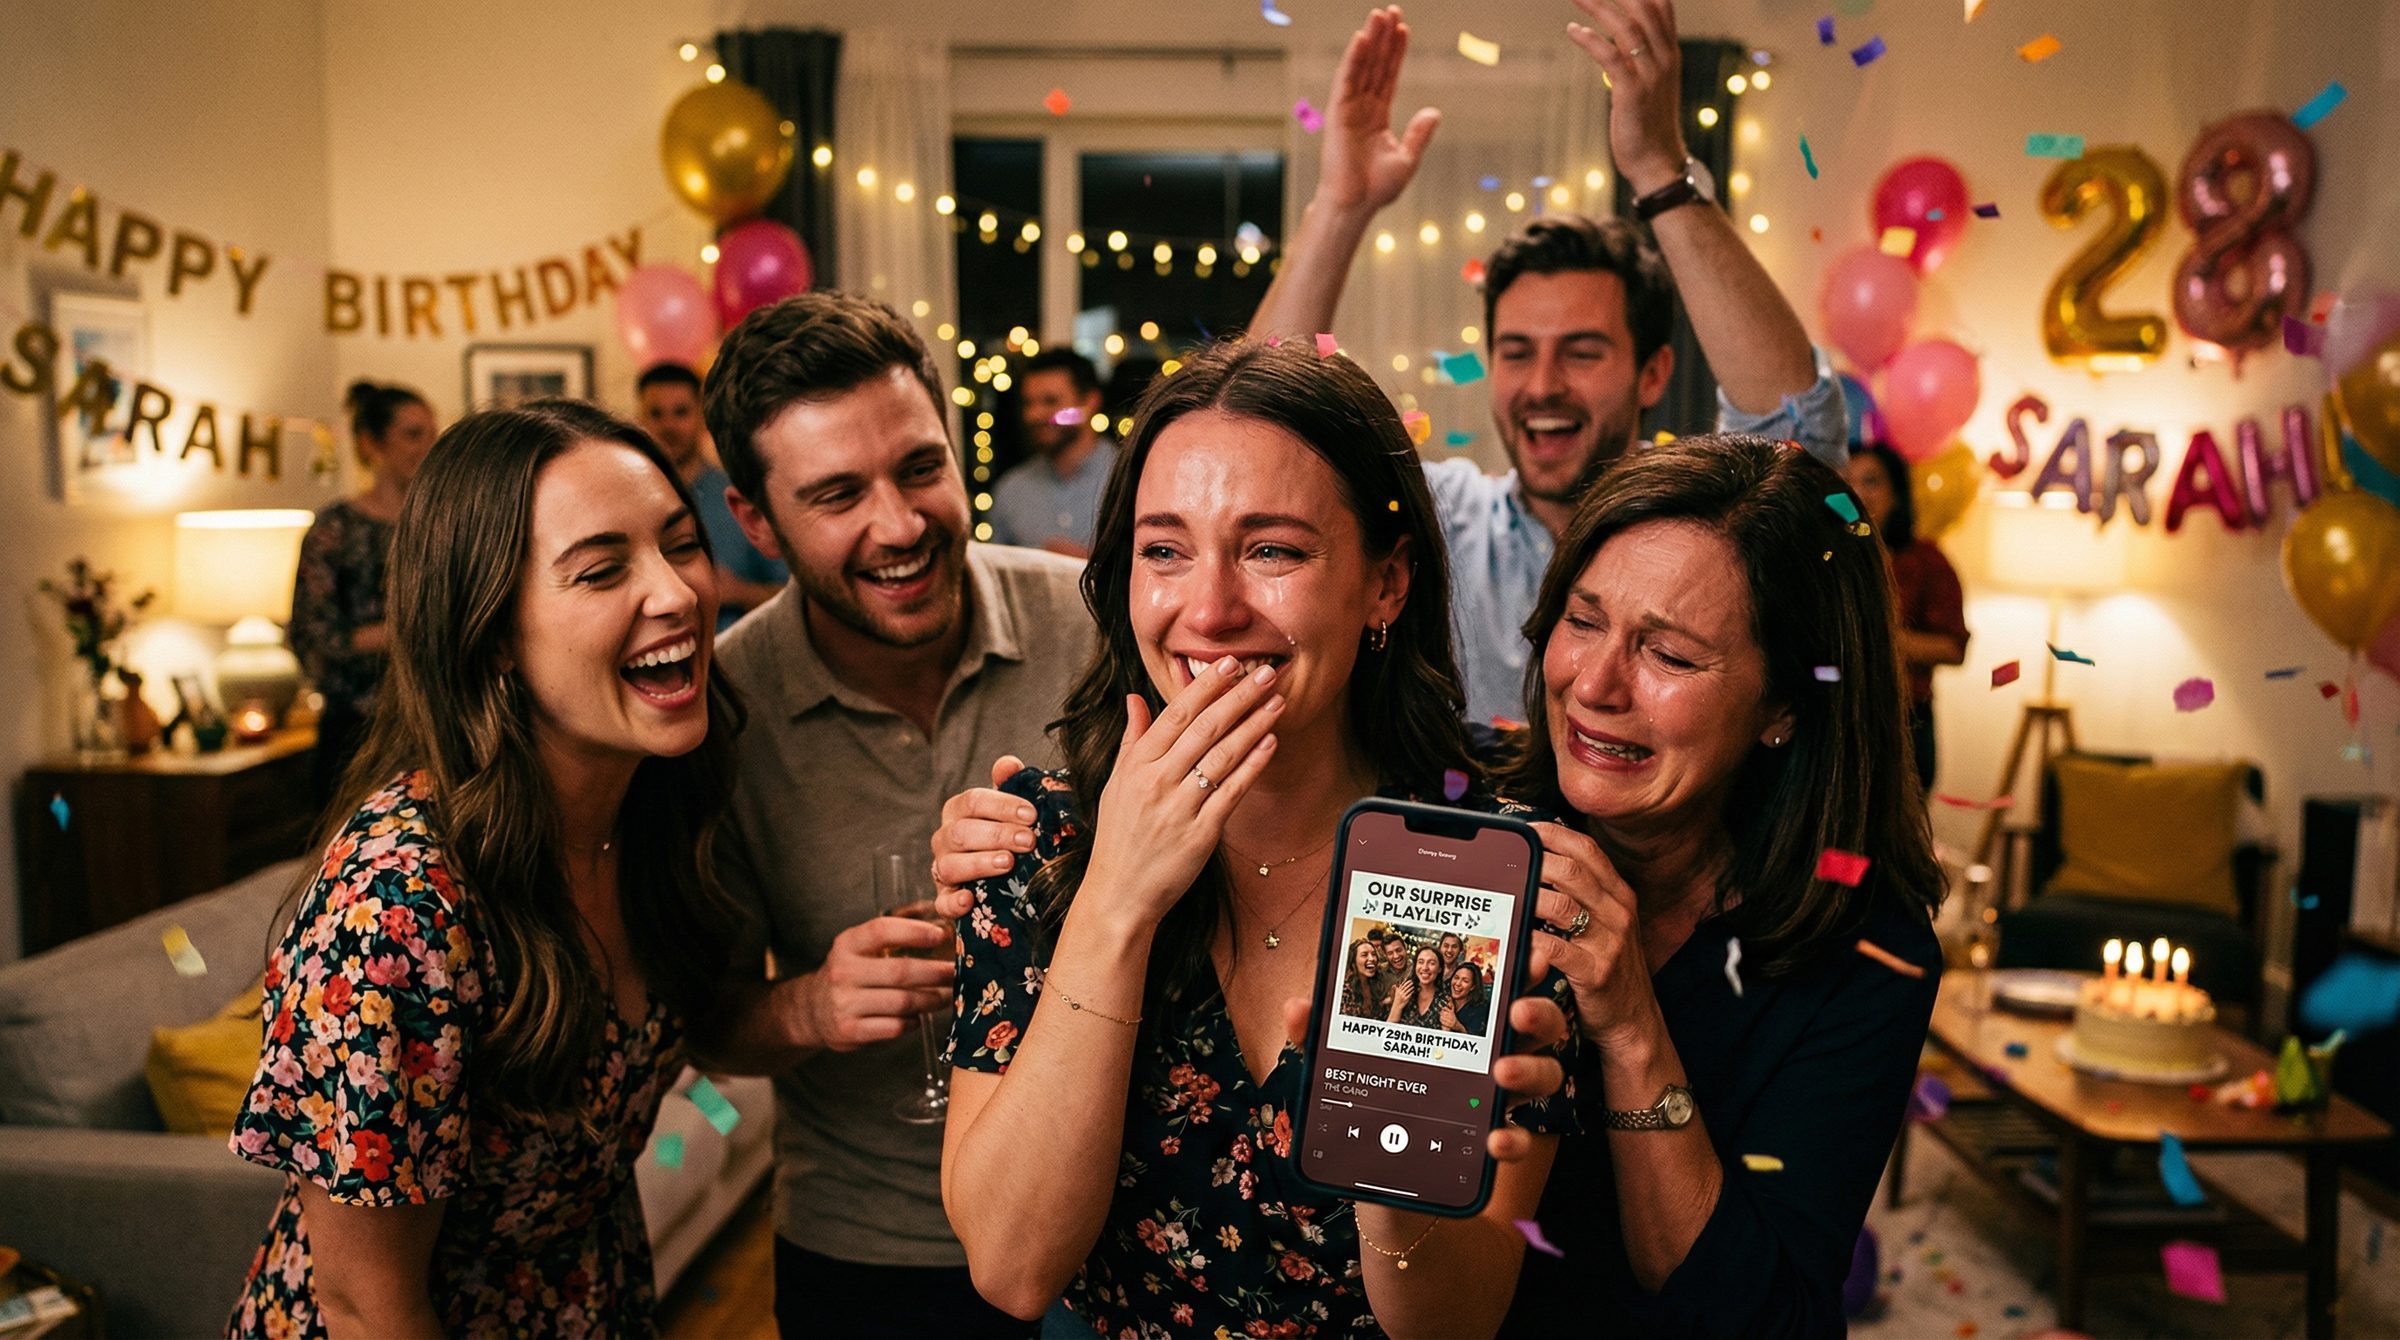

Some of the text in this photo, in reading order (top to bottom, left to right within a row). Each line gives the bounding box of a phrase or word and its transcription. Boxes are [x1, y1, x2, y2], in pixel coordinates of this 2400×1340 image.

[0, 148, 645, 340] HAPPY BIRTHDAY
[2038, 110, 2318, 372] 28
[0, 321, 283, 482] SARAH
[1367, 881, 1493, 913] OUR SURPRISE
[1382, 902, 1463, 927] PLAYLIST
[1342, 1021, 1479, 1056] HAPPY 29th BIRTHDAY,
[1383, 1041, 1431, 1058] SARAH!
[1324, 1067, 1428, 1095] BEST NIGHT EVER
